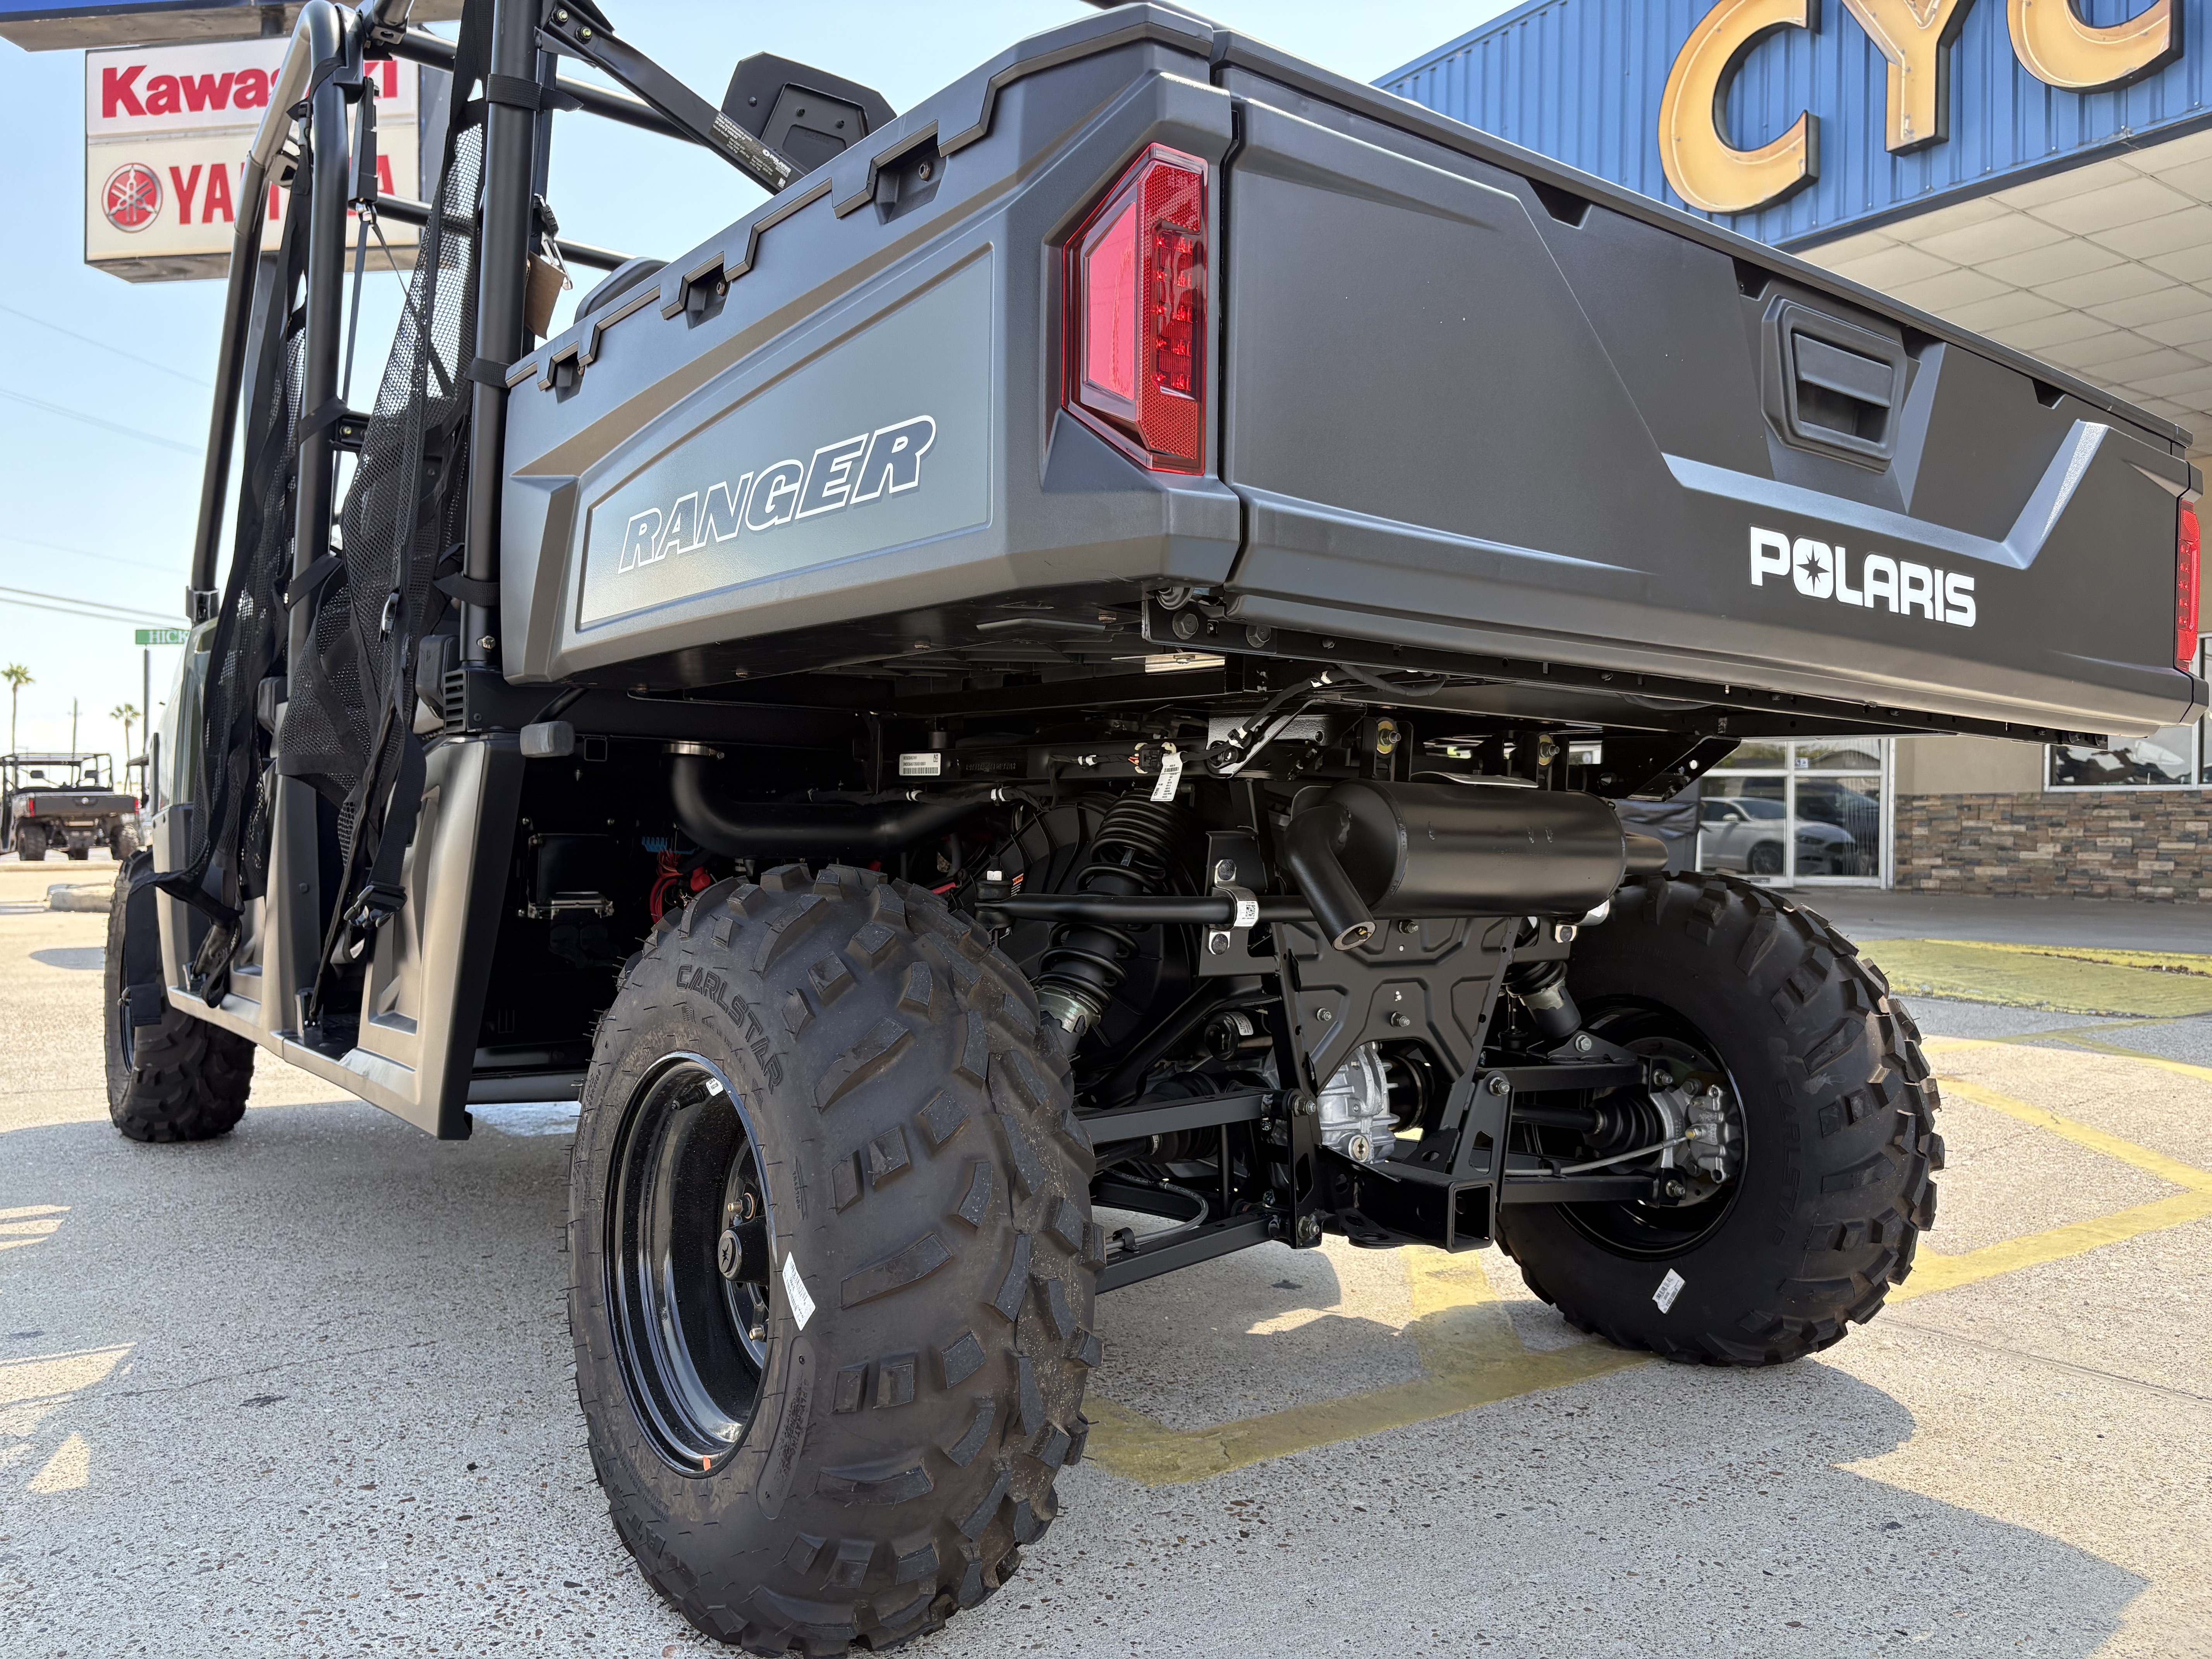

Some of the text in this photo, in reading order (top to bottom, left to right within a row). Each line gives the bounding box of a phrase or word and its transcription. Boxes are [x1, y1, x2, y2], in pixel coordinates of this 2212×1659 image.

[617, 415, 936, 574] RANGER
[1750, 526, 1976, 628] POLARIS
[676, 964, 782, 1095] CARLSTAR
